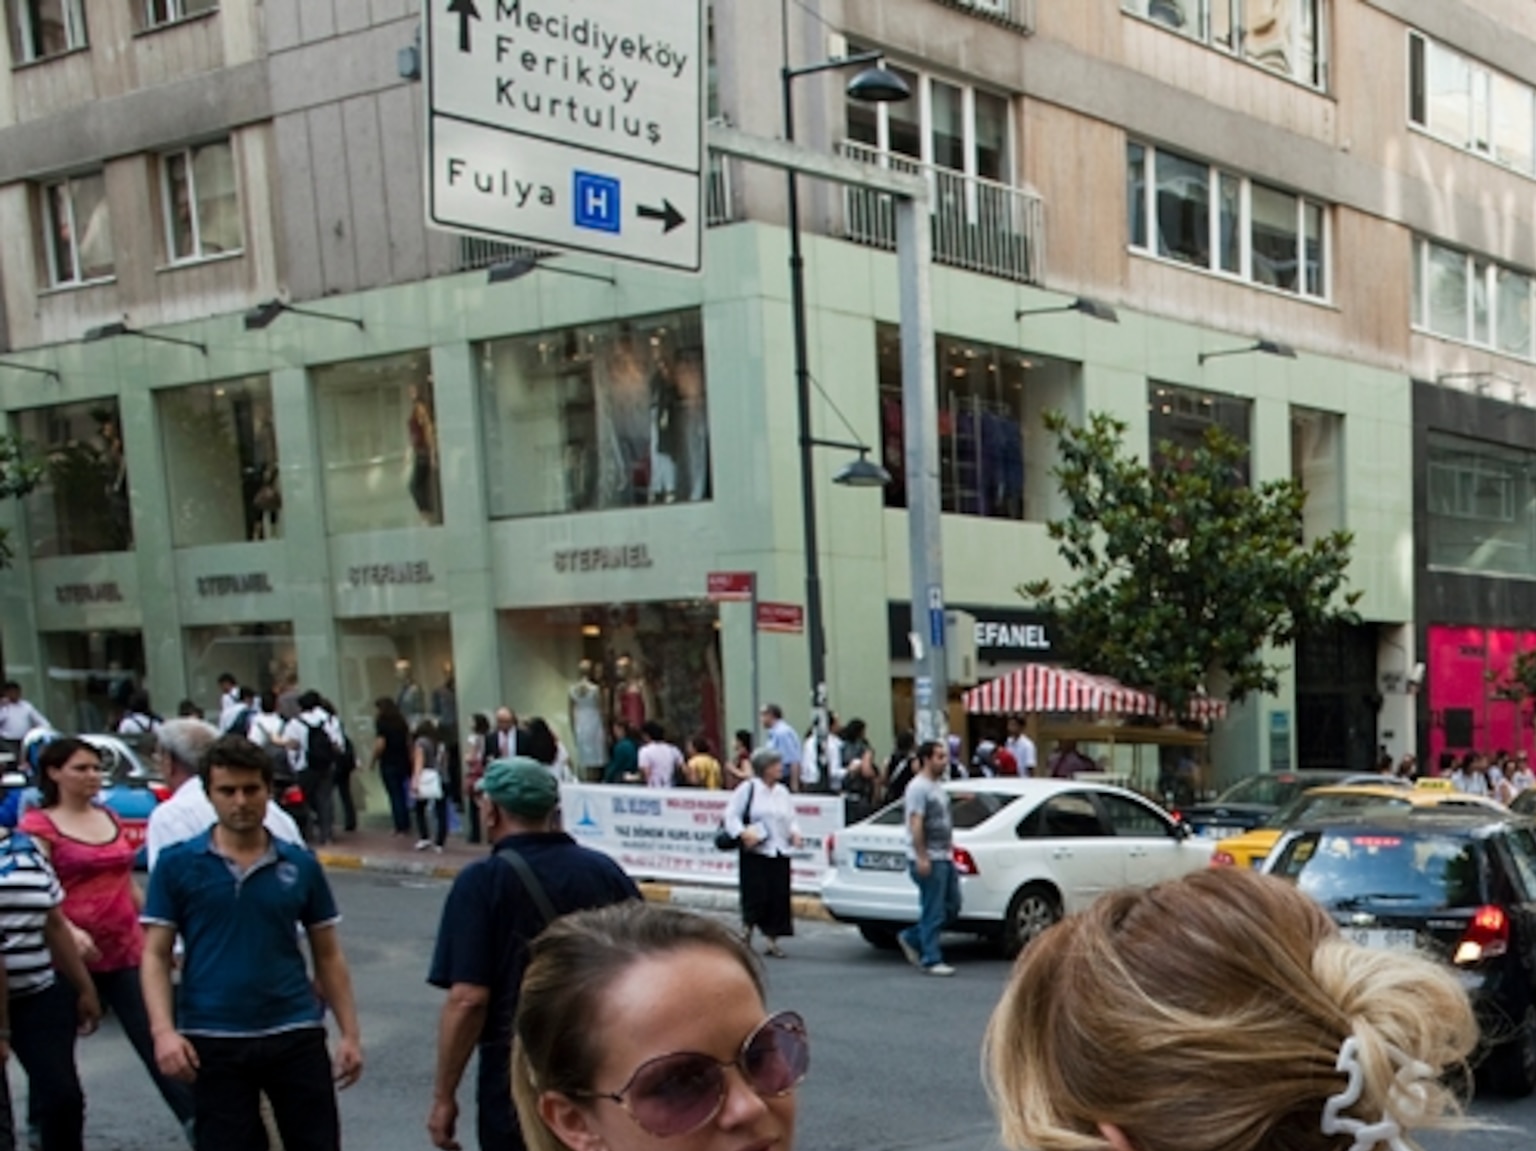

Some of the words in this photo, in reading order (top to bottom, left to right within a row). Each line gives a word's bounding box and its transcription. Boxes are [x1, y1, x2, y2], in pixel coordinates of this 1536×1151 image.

[495, 0, 688, 79] Mecidiyeköy
[495, 34, 639, 103] Feriköy
[495, 76, 662, 146] Kurtuluş
[448, 158, 556, 209] Fulya
[553, 543, 654, 574] STEFANEL
